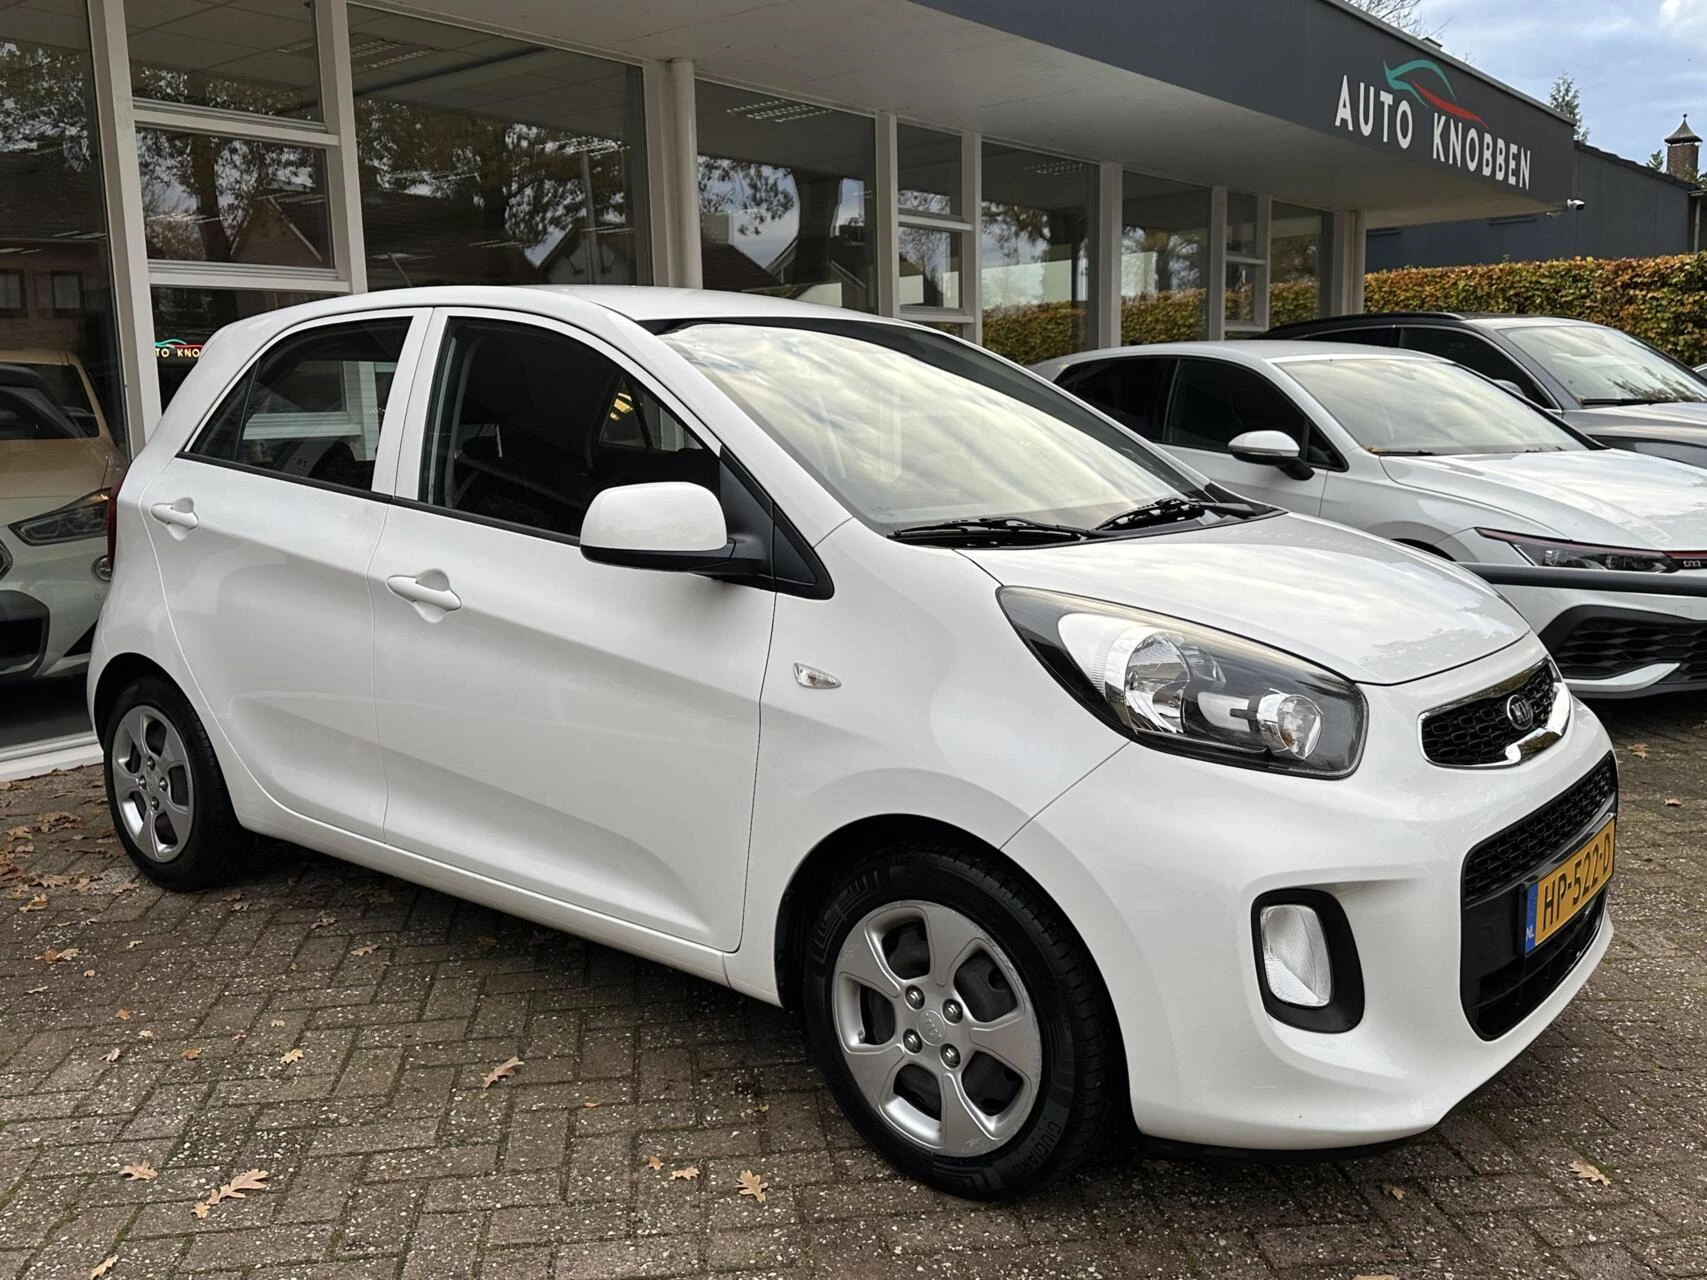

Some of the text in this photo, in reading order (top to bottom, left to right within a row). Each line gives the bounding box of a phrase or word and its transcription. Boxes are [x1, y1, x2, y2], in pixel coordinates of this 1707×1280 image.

[1335, 74, 1531, 190] AUTO KNOBBEN
[155, 348, 201, 358] TO KNO
[1543, 833, 1611, 932] HP-522-D
[1525, 926, 1535, 941] NL
